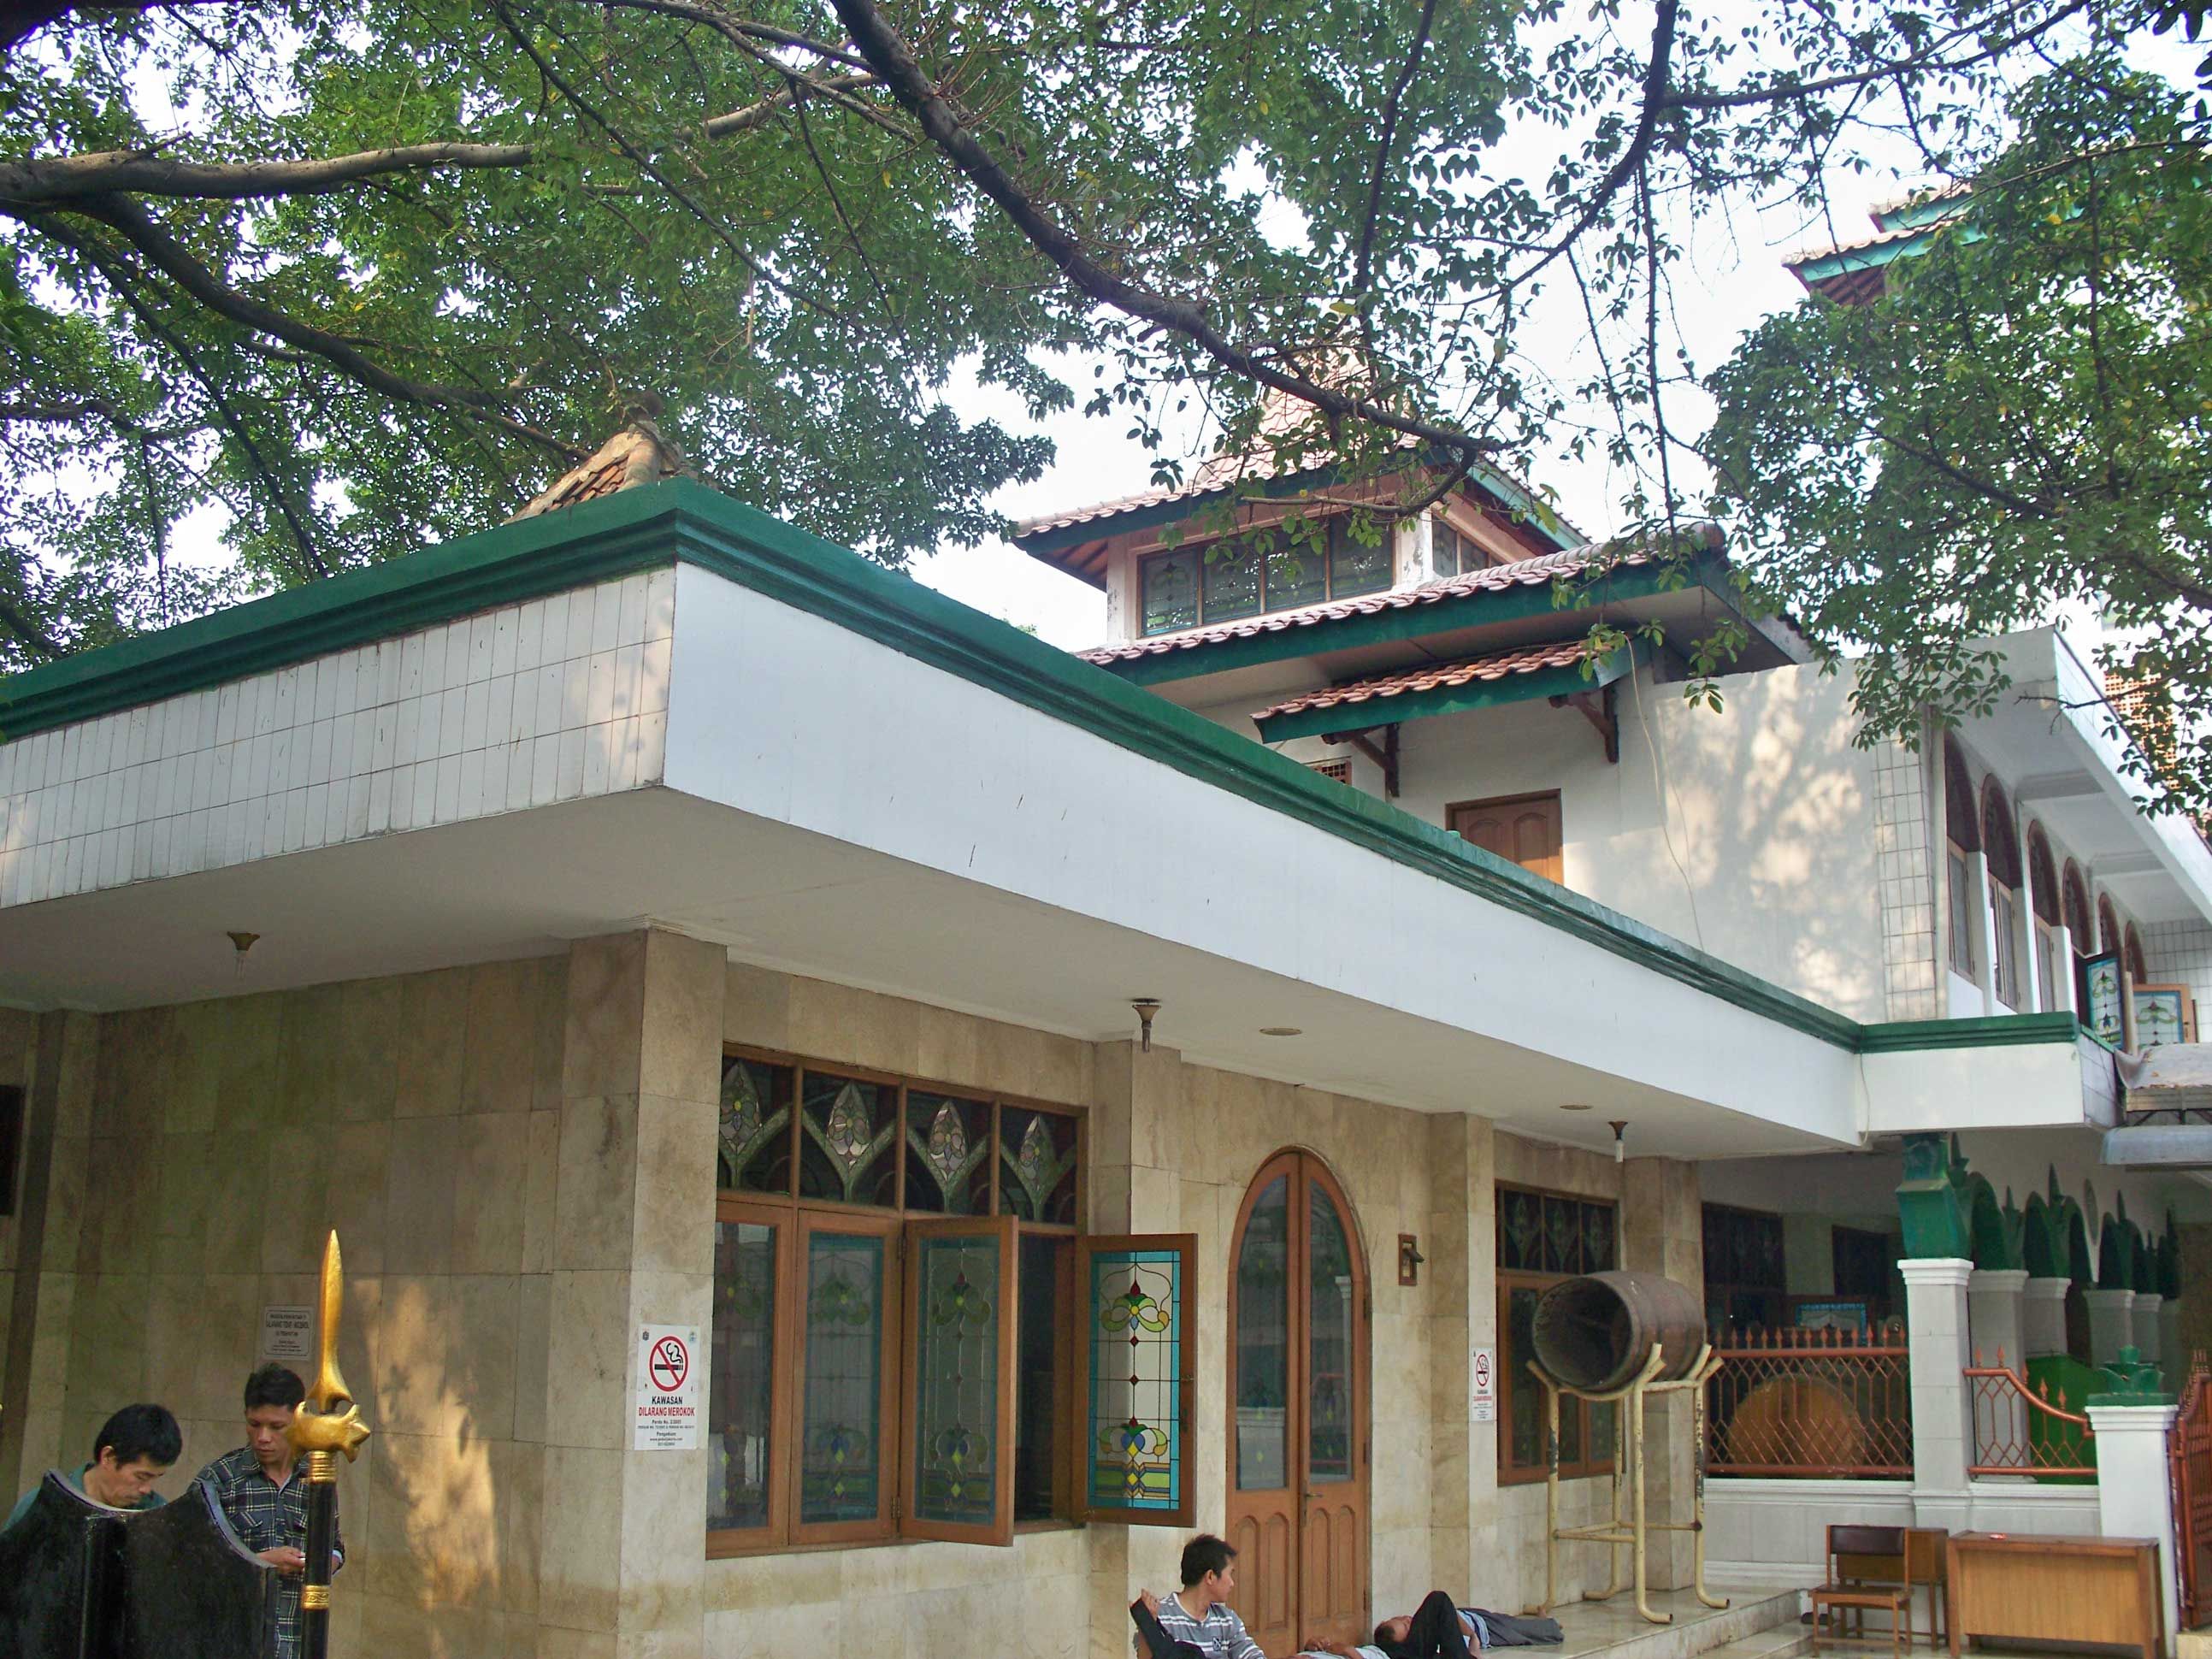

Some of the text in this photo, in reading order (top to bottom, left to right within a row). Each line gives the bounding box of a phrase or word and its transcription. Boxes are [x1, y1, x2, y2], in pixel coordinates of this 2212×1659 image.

[652, 1396, 683, 1405] KAWASAN
[639, 1407, 695, 1416] DILARANG MEROKOK
